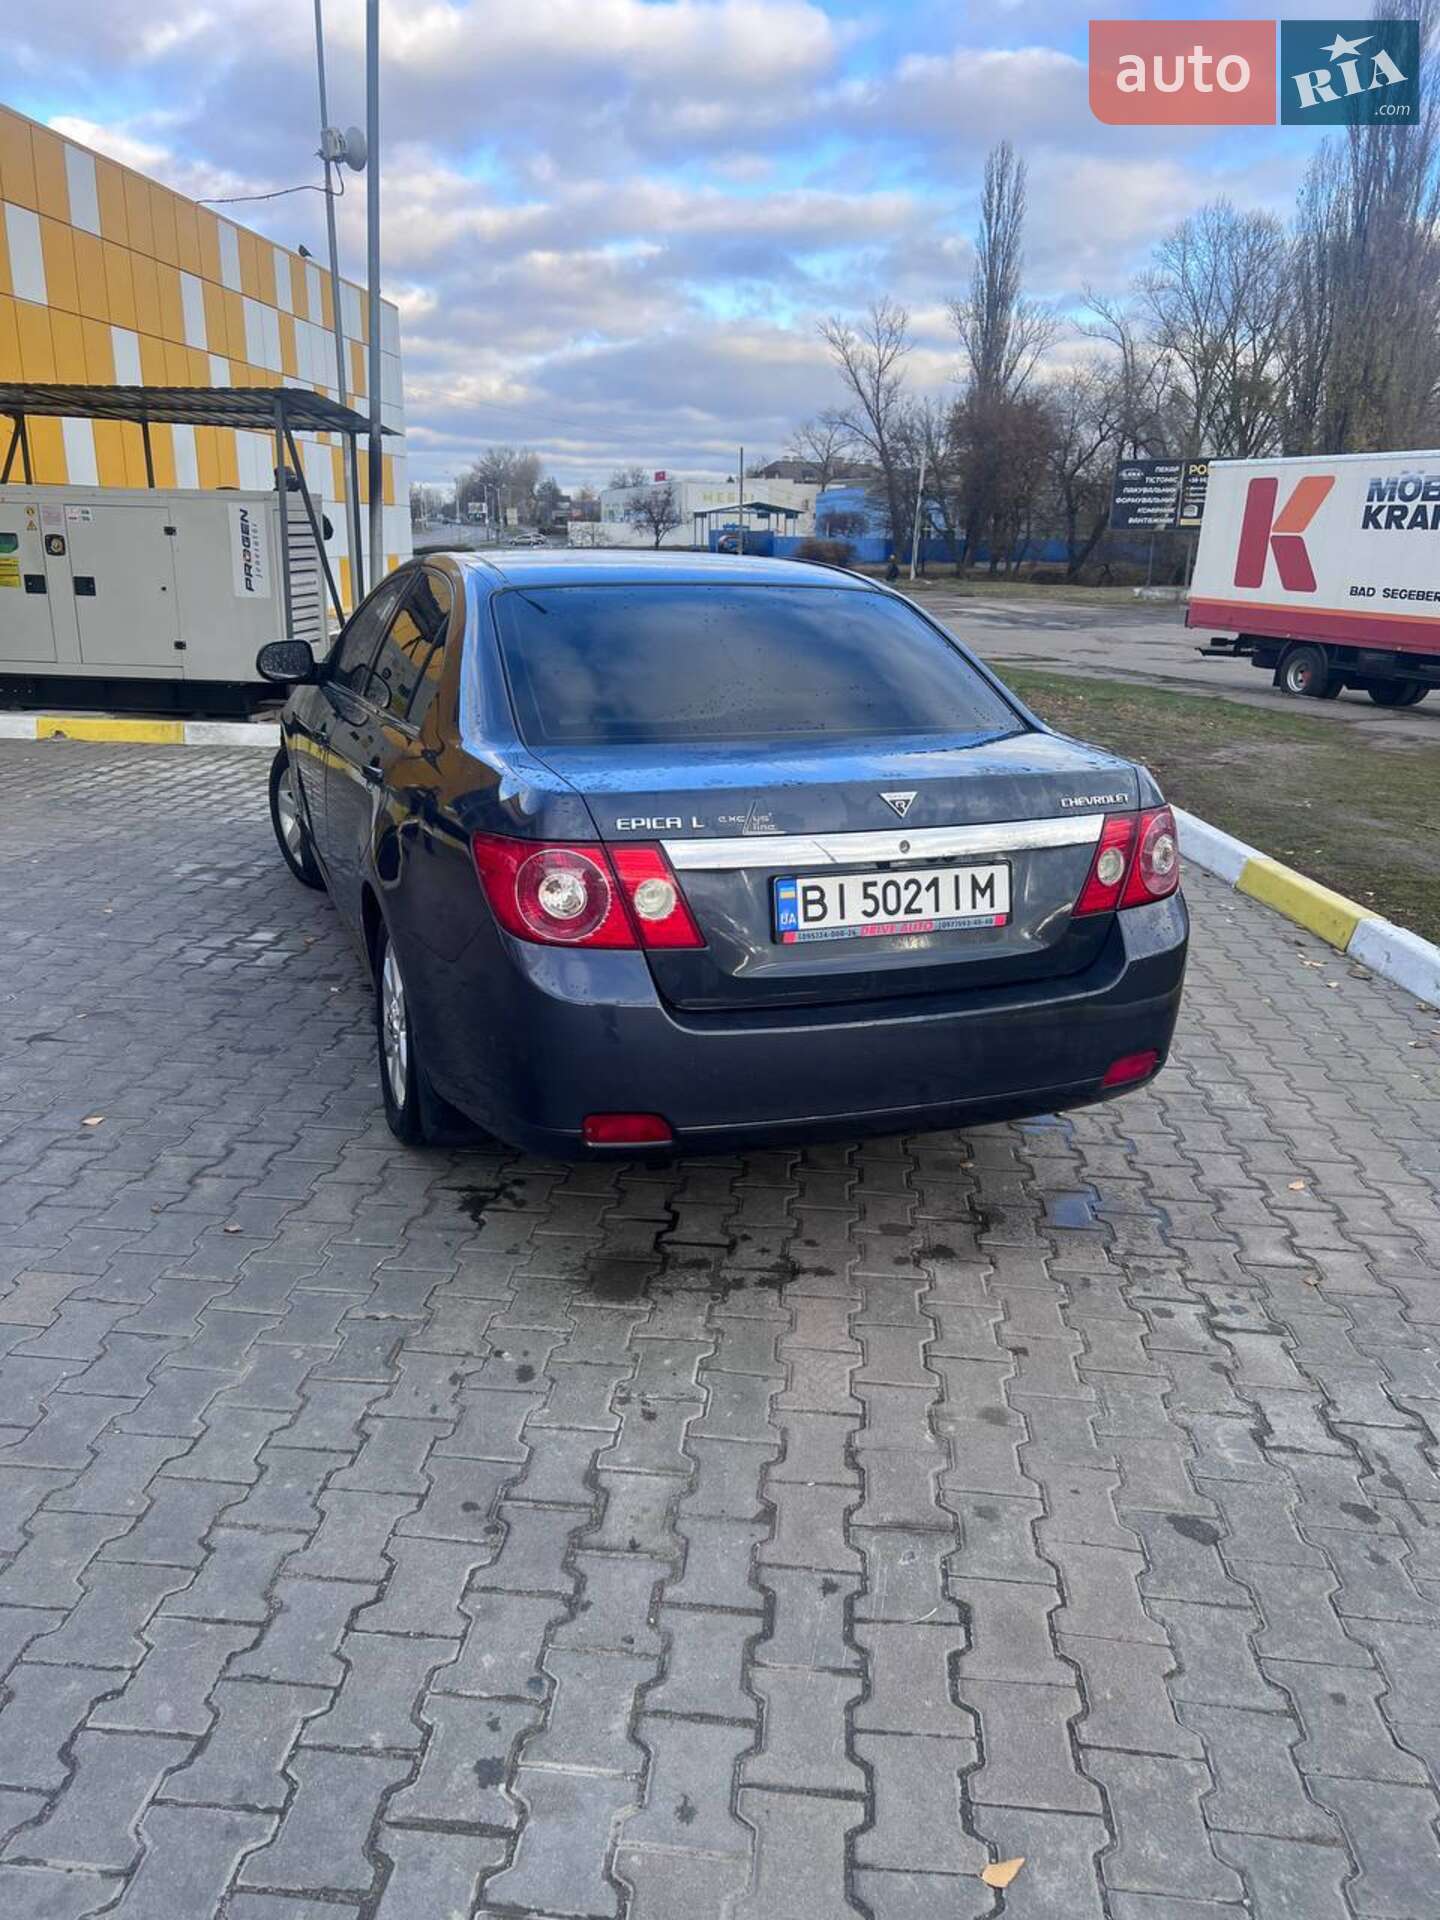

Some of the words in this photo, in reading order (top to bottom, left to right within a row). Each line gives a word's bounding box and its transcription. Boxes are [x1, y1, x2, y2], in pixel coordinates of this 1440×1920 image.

[240, 508, 255, 592] PROGEN
[1349, 585, 1376, 597] BAD
[1061, 793, 1128, 808] CHEVROLET
[616, 816, 682, 830] EPICA
[692, 816, 705, 828] L
[801, 883, 845, 923] BI
[861, 876, 940, 918] 5021
[954, 872, 995, 911] IM
[780, 912, 797, 925] UA
